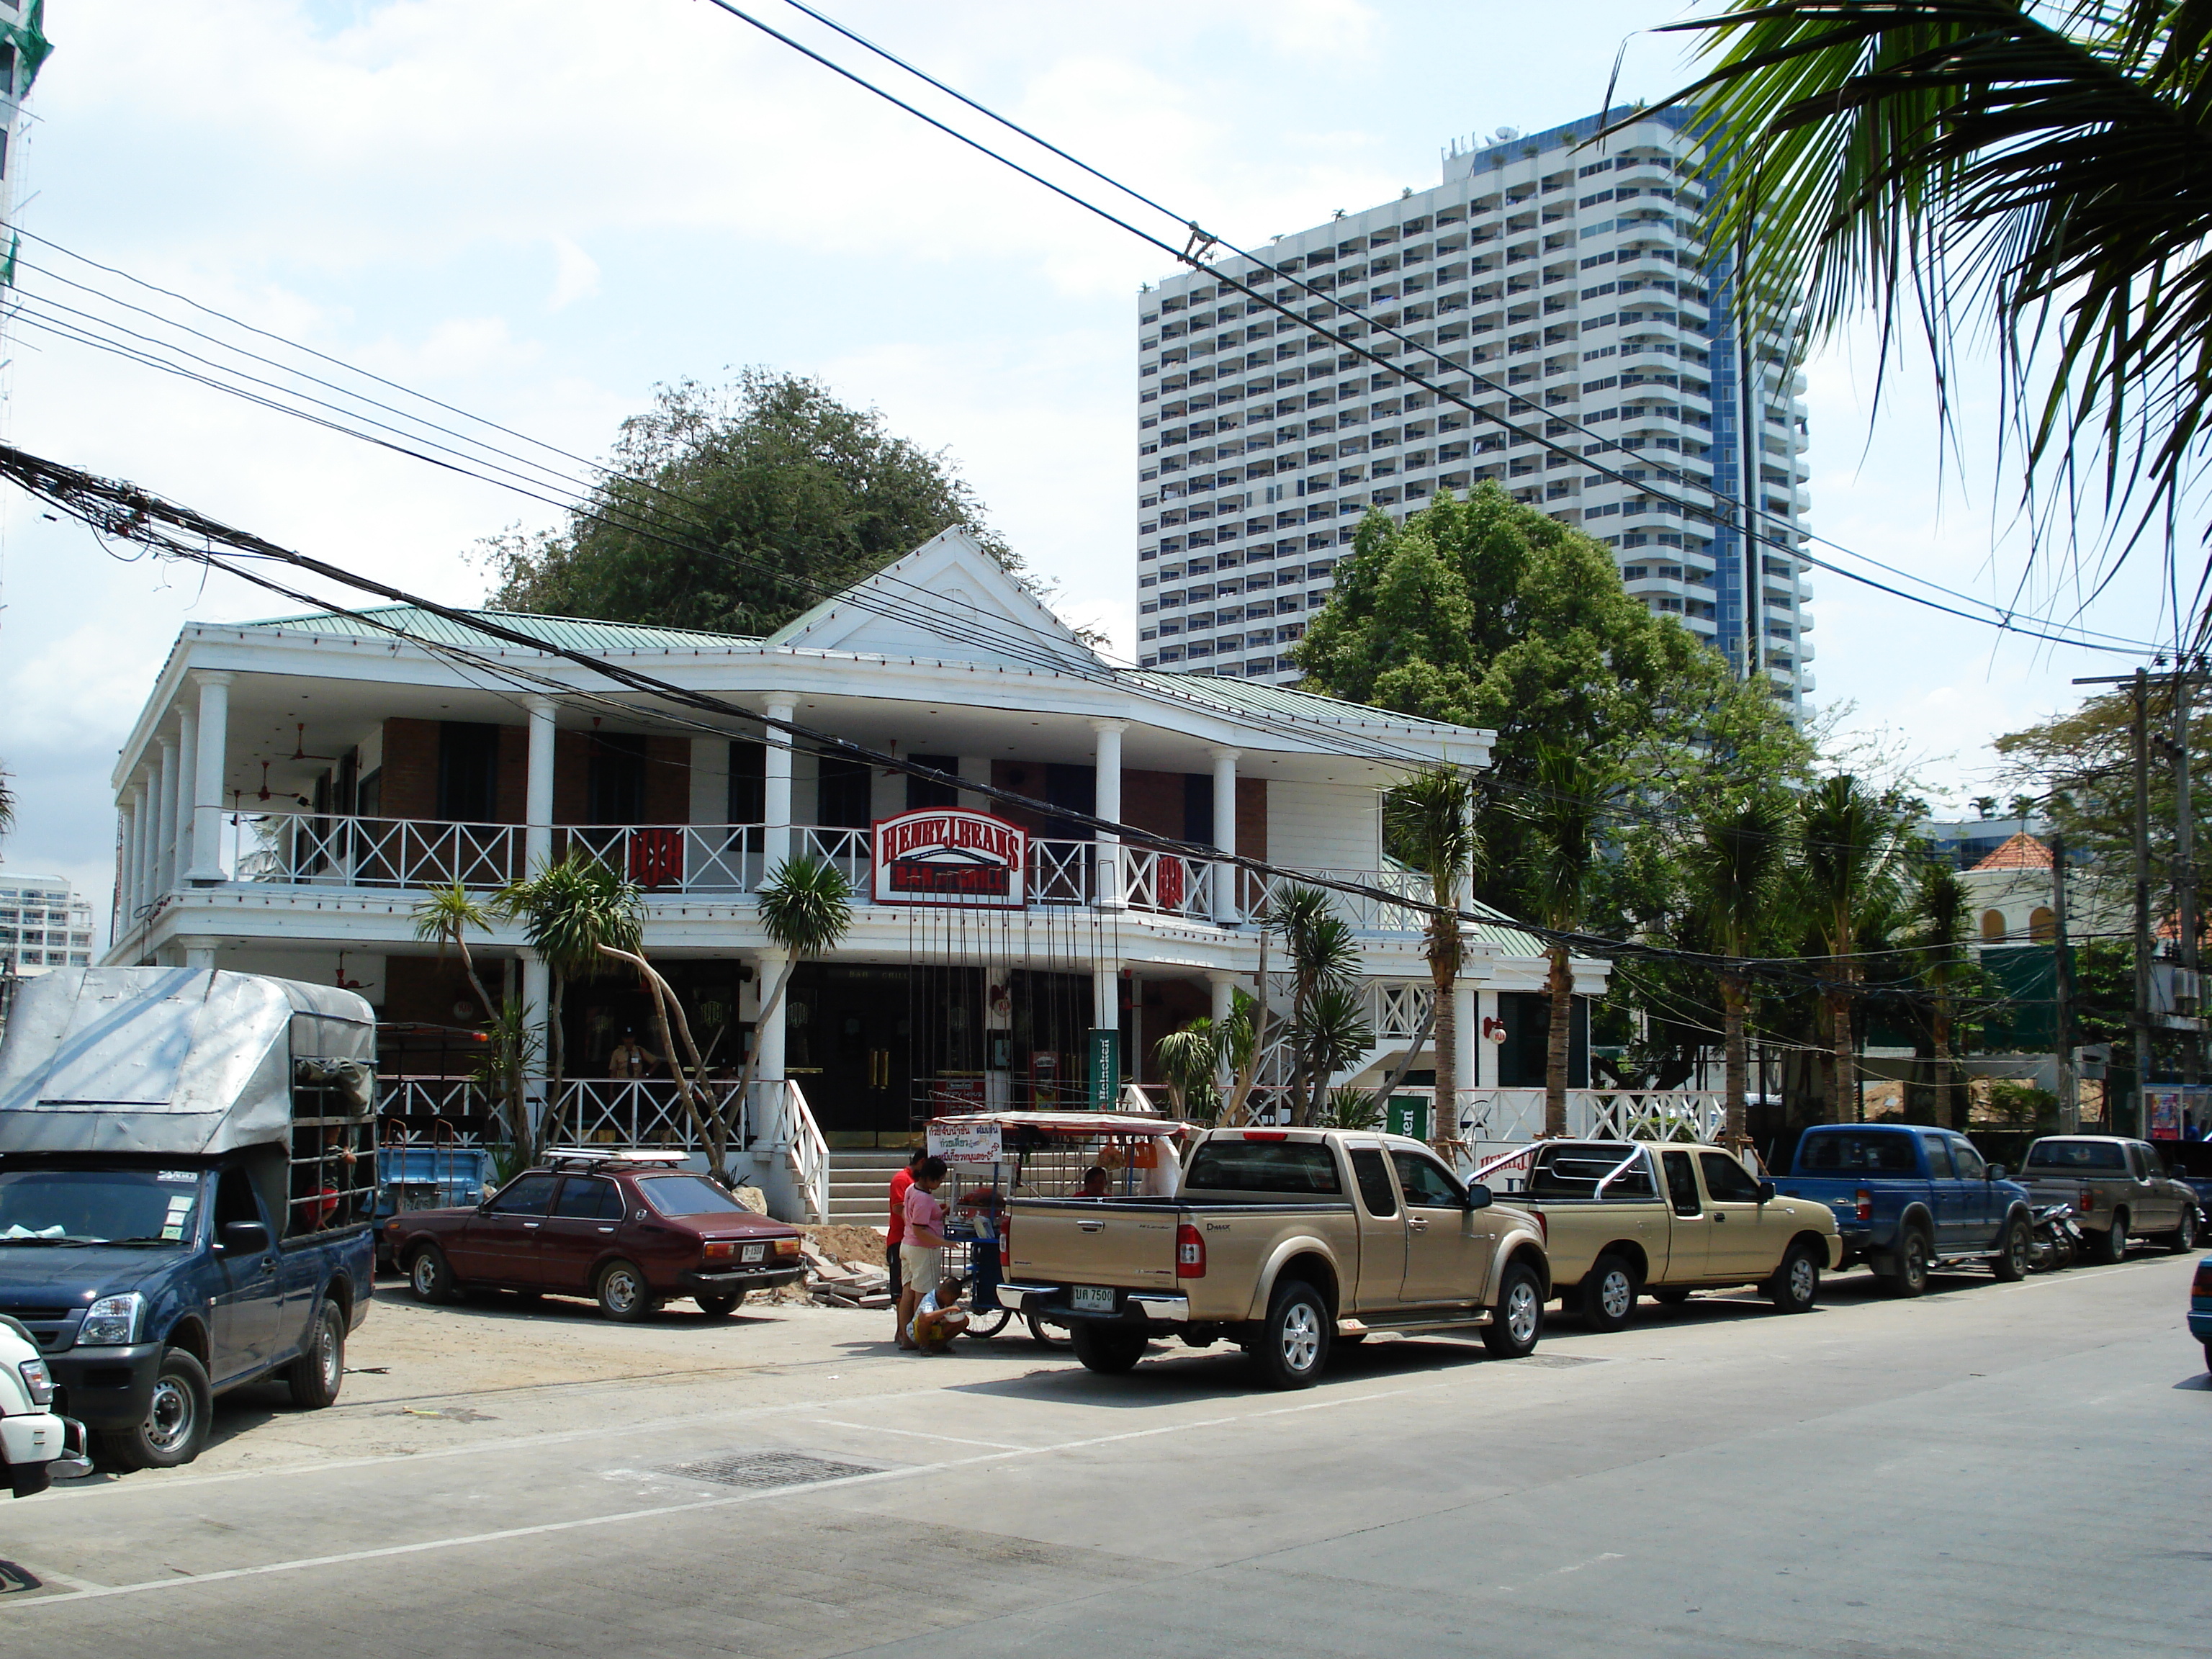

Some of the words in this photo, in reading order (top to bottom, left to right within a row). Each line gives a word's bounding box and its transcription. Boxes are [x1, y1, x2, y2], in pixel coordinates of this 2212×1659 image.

[882, 819, 947, 867] HENRY
[958, 819, 1020, 872] BEAN'S
[896, 866, 933, 886] BAR
[957, 869, 1002, 889] GRILL
[1099, 1039, 1110, 1100] Heineken
[1091, 1290, 1112, 1301] 7500
